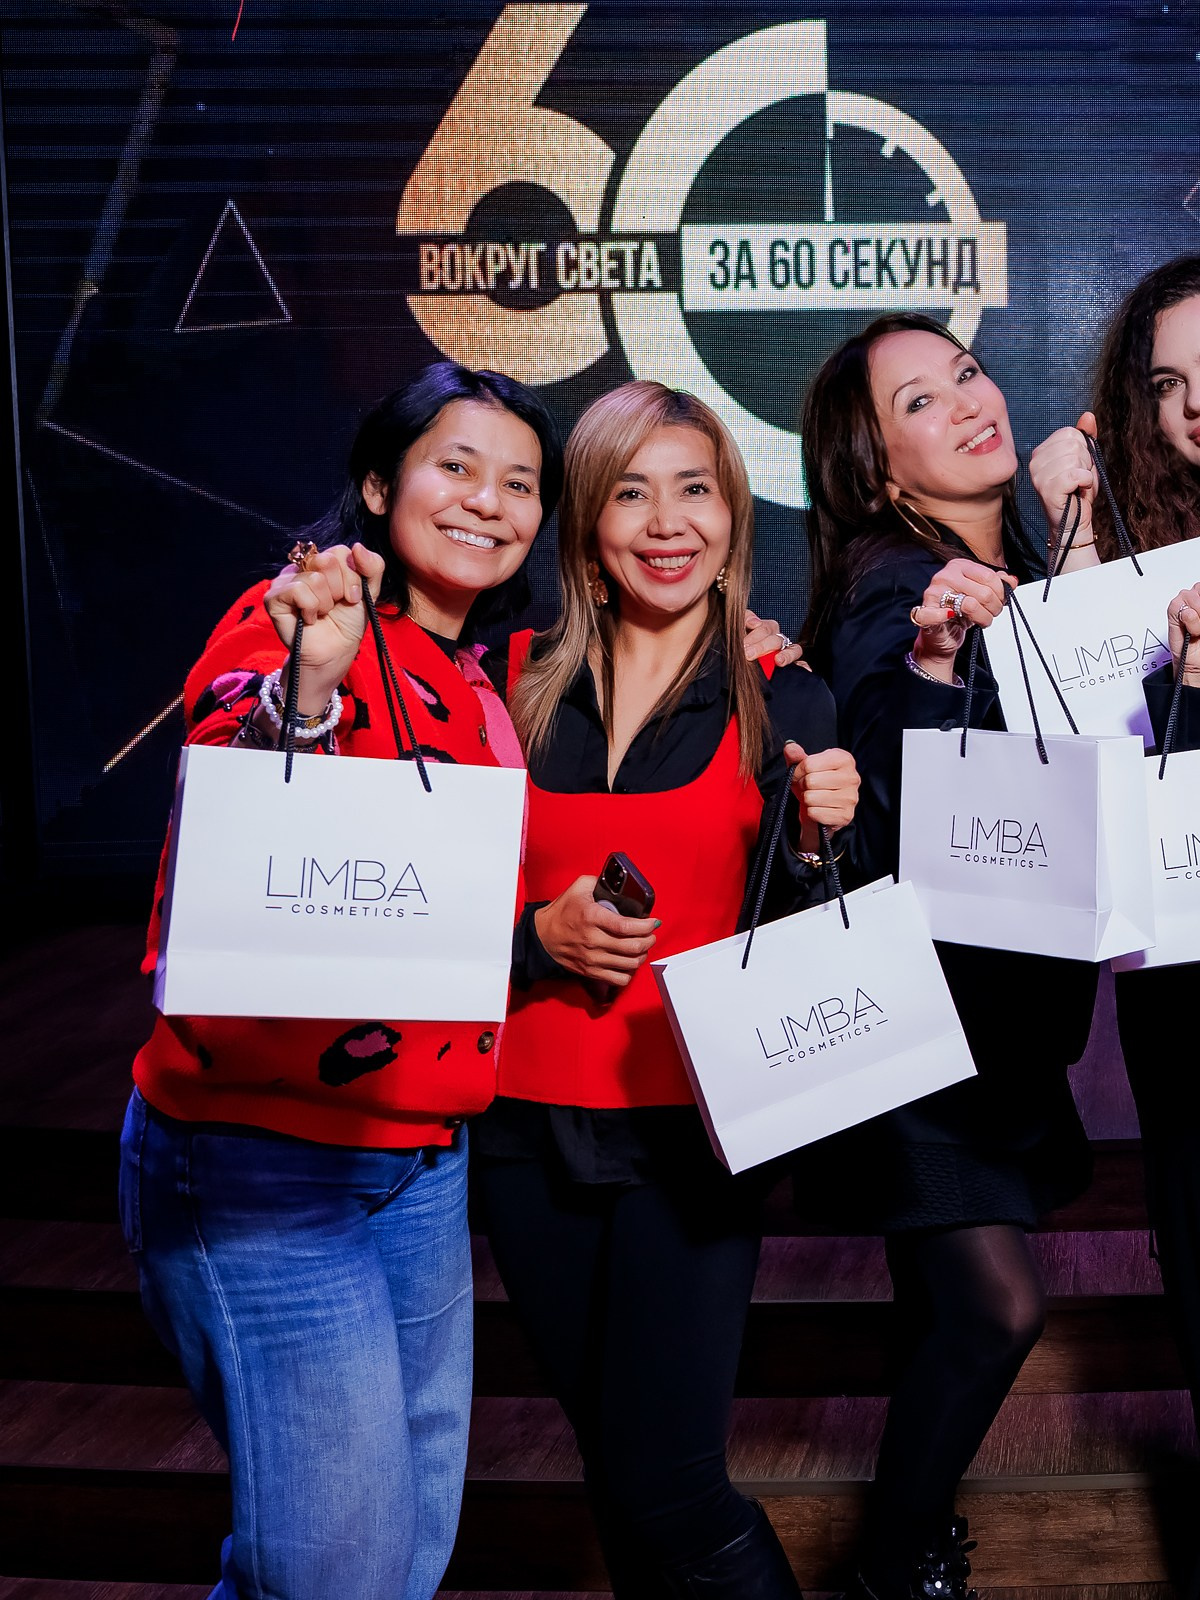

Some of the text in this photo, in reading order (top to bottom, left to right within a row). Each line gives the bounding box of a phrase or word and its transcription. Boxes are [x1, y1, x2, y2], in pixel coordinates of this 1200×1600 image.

[418, 237, 981, 293] ВОКРУГ СВЕТА ЗА 60 СЕКУНД
[1052, 628, 1170, 682] LIMBA
[1079, 661, 1158, 689] COSMETICS
[950, 814, 1047, 857] LIMBA
[266, 855, 428, 904] LIMBA
[964, 853, 1034, 868] COSMETICS
[291, 903, 405, 918] COSMETICS
[756, 987, 884, 1059] LIMBA
[787, 1024, 871, 1063] COSMETICS
